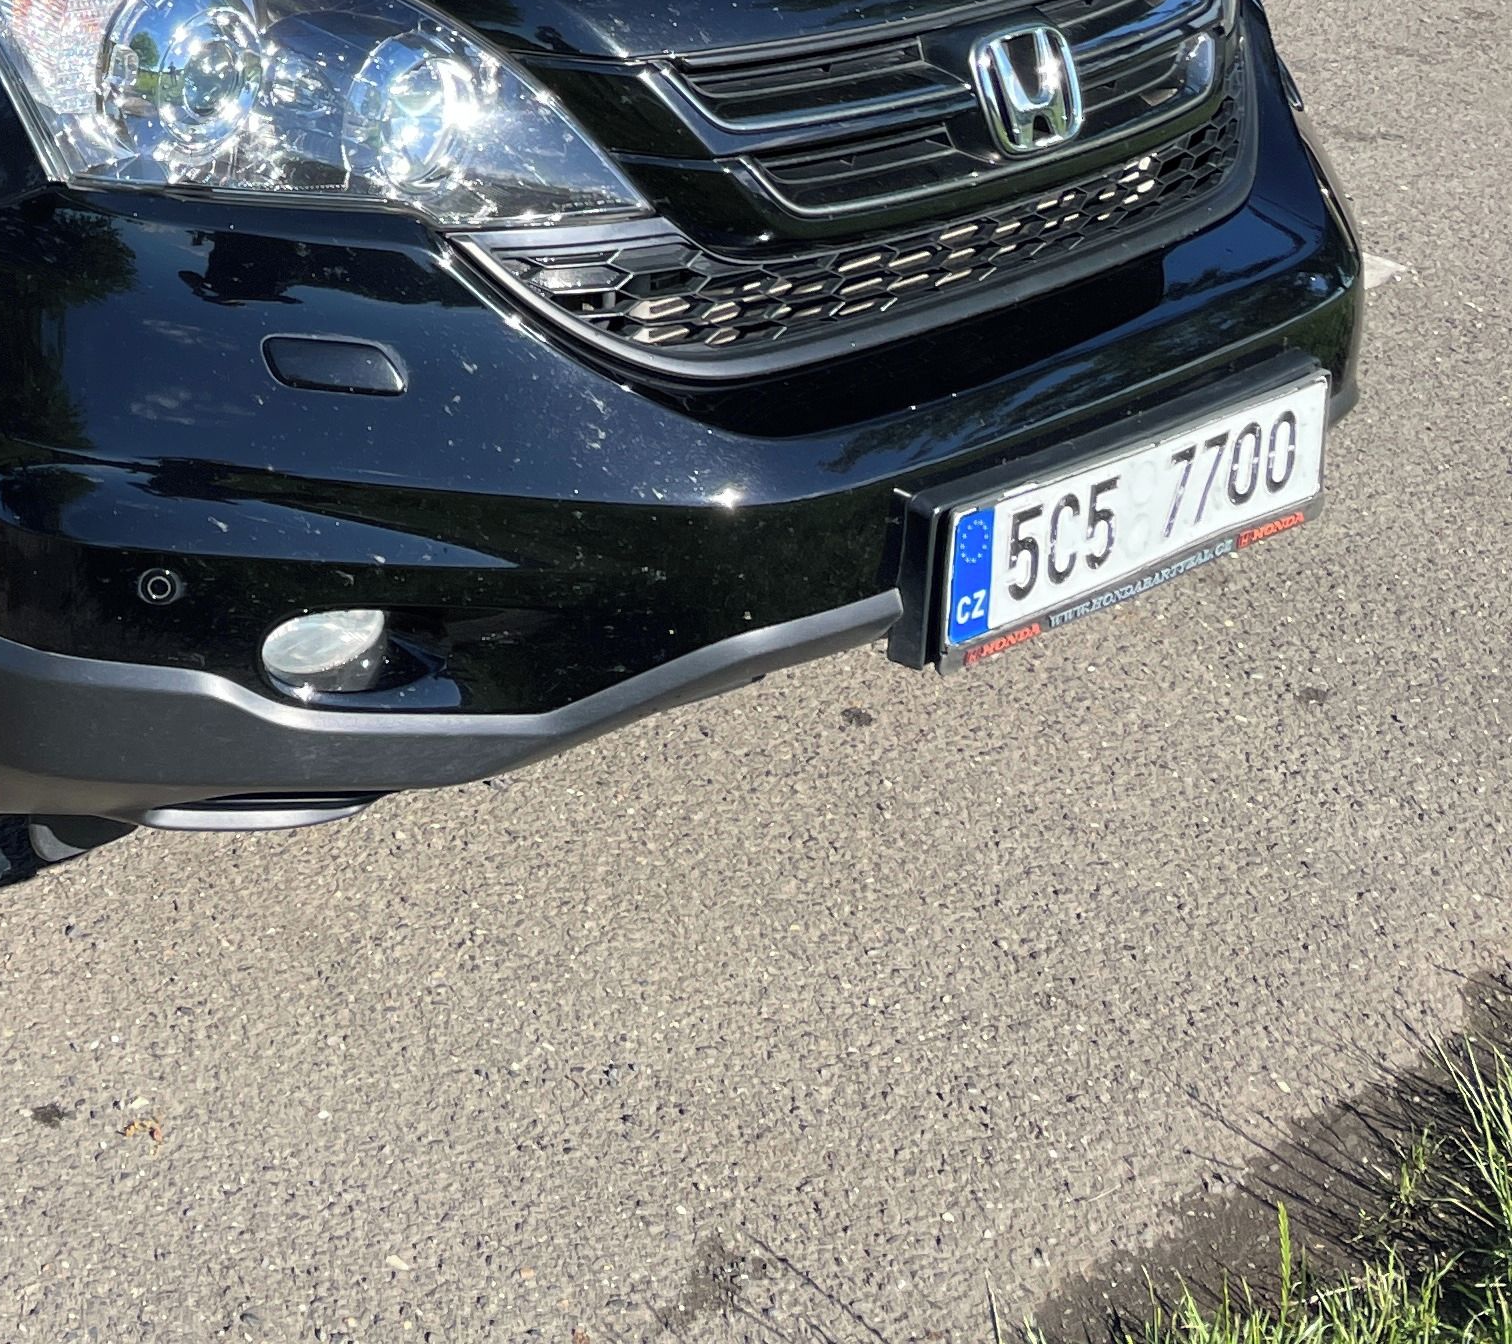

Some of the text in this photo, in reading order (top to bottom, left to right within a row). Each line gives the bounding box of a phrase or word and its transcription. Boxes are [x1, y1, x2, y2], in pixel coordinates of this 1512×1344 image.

[1006, 409, 1297, 601] 5C5 7700
[1251, 511, 1305, 541] HONDA
[956, 590, 986, 625] CZ
[982, 622, 1041, 658] HONDA
